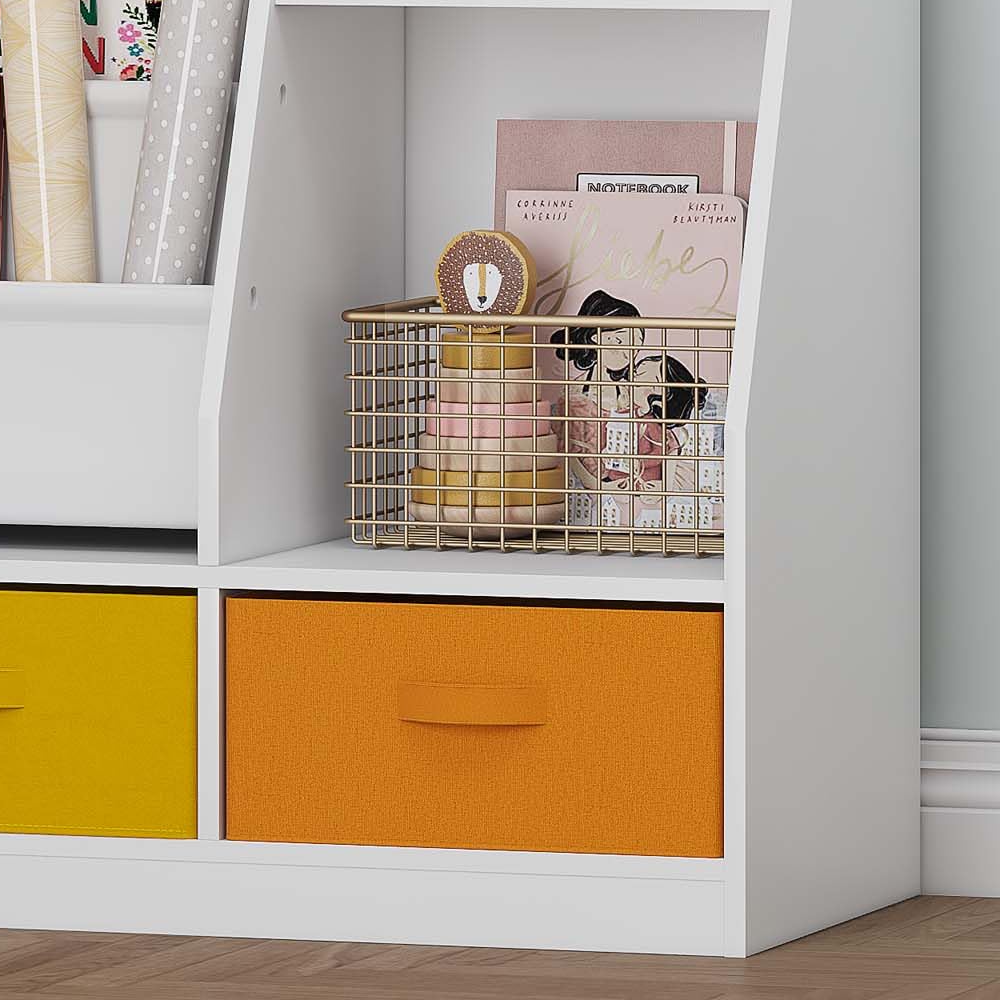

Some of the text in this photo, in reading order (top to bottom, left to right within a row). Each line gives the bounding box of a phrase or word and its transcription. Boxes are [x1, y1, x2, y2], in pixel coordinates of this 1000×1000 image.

[586, 182, 691, 194] NOTEBOOK
[516, 199, 725, 212] CORRINNE KIRSTI
[523, 212, 738, 225] AVERISS BEAUTYMAN
